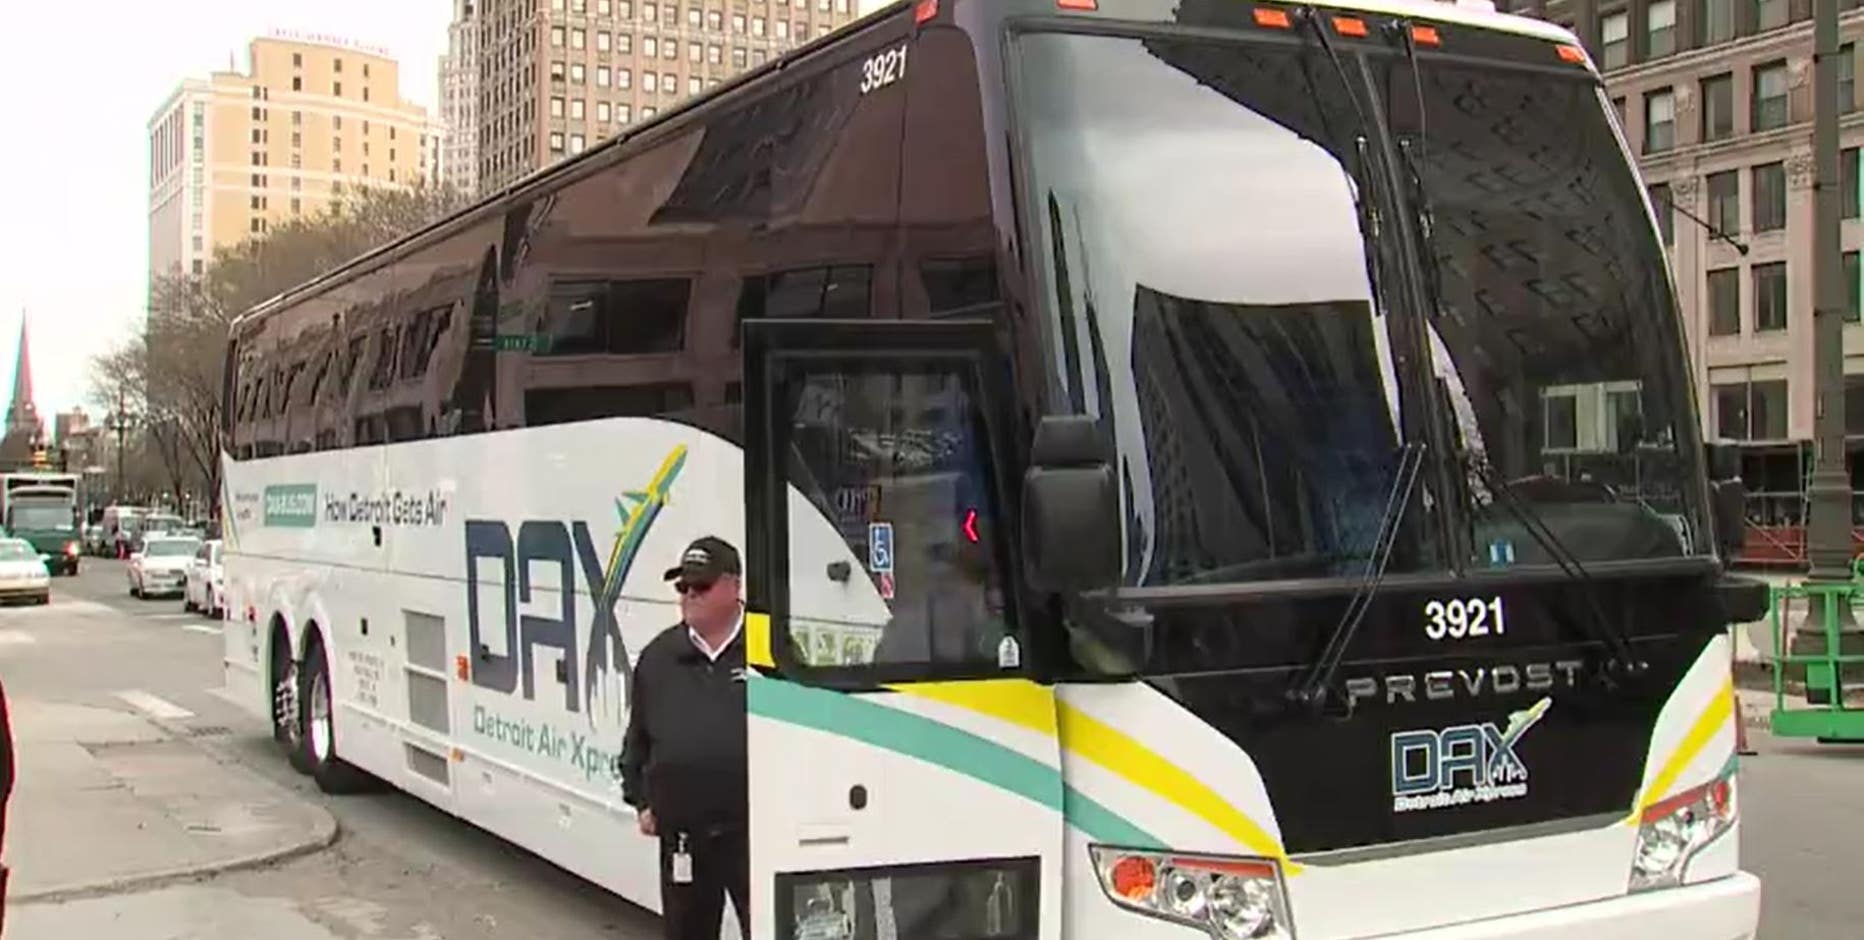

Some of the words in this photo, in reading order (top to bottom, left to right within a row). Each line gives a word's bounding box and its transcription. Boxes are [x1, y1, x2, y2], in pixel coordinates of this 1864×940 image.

[861, 44, 907, 93] 3921
[324, 492, 347, 522] How
[348, 491, 390, 523] Detroit
[393, 490, 422, 525] Gets
[424, 488, 447, 525] Air
[465, 490, 655, 732] DAX
[1425, 596, 1504, 639] 3921
[1346, 660, 1582, 708] PREVOST
[474, 704, 535, 752] Detroit
[537, 723, 567, 757] Air
[571, 730, 622, 782] Xpre
[1391, 710, 1544, 796] DAX
[1394, 792, 1451, 812] Detroit
[1452, 787, 1475, 804] Air
